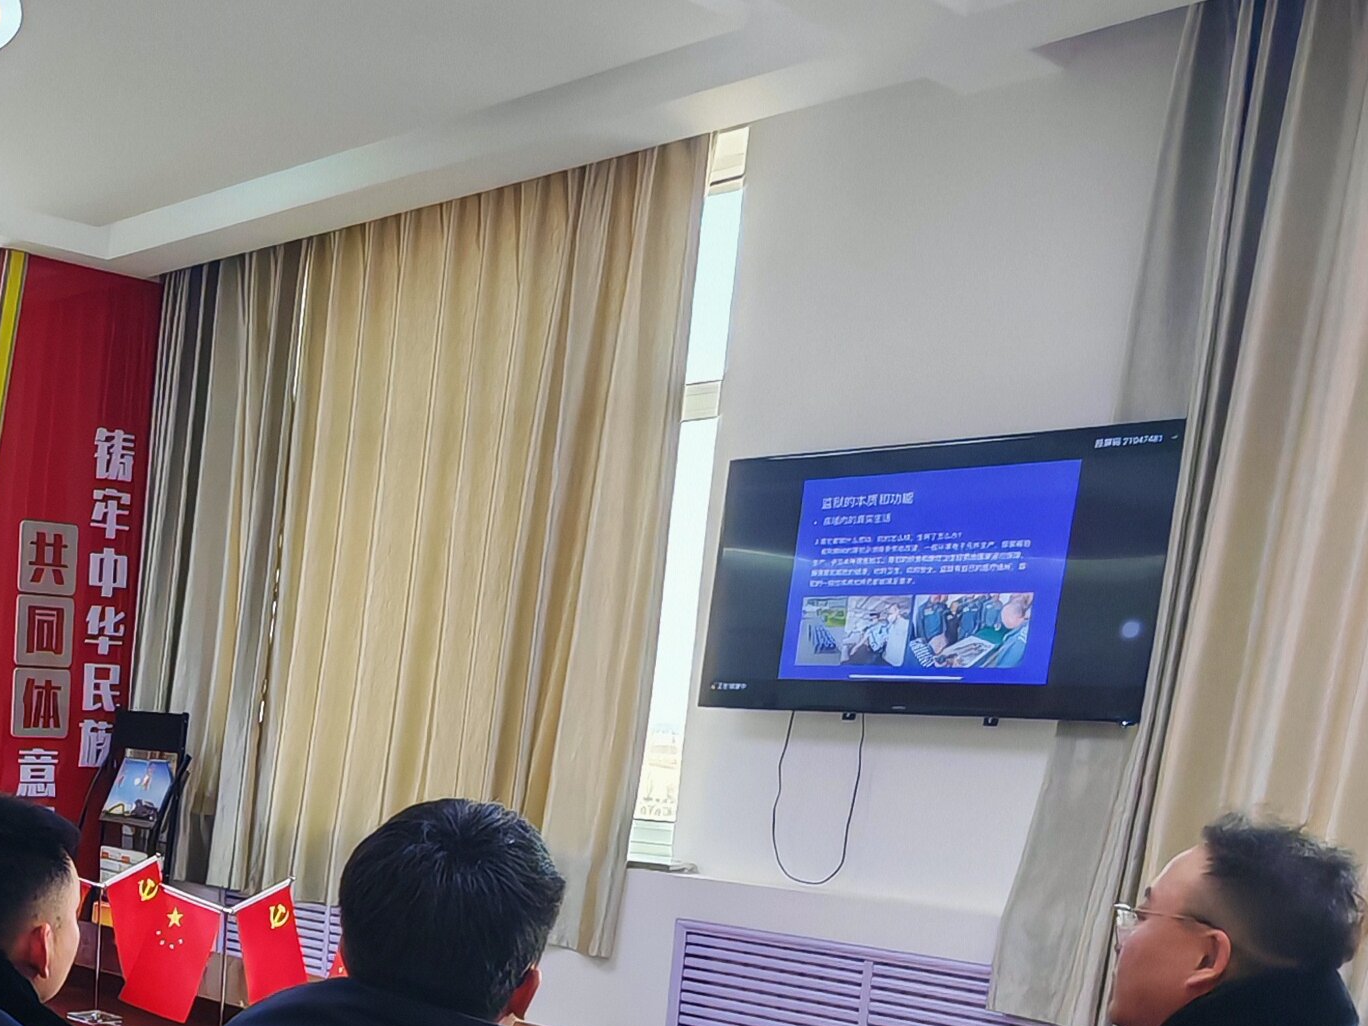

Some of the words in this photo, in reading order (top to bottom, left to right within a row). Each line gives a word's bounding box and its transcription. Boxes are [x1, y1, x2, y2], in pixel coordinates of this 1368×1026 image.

[15, 531, 69, 812] 共同体意
[79, 427, 135, 768] 铸牢中华民族
